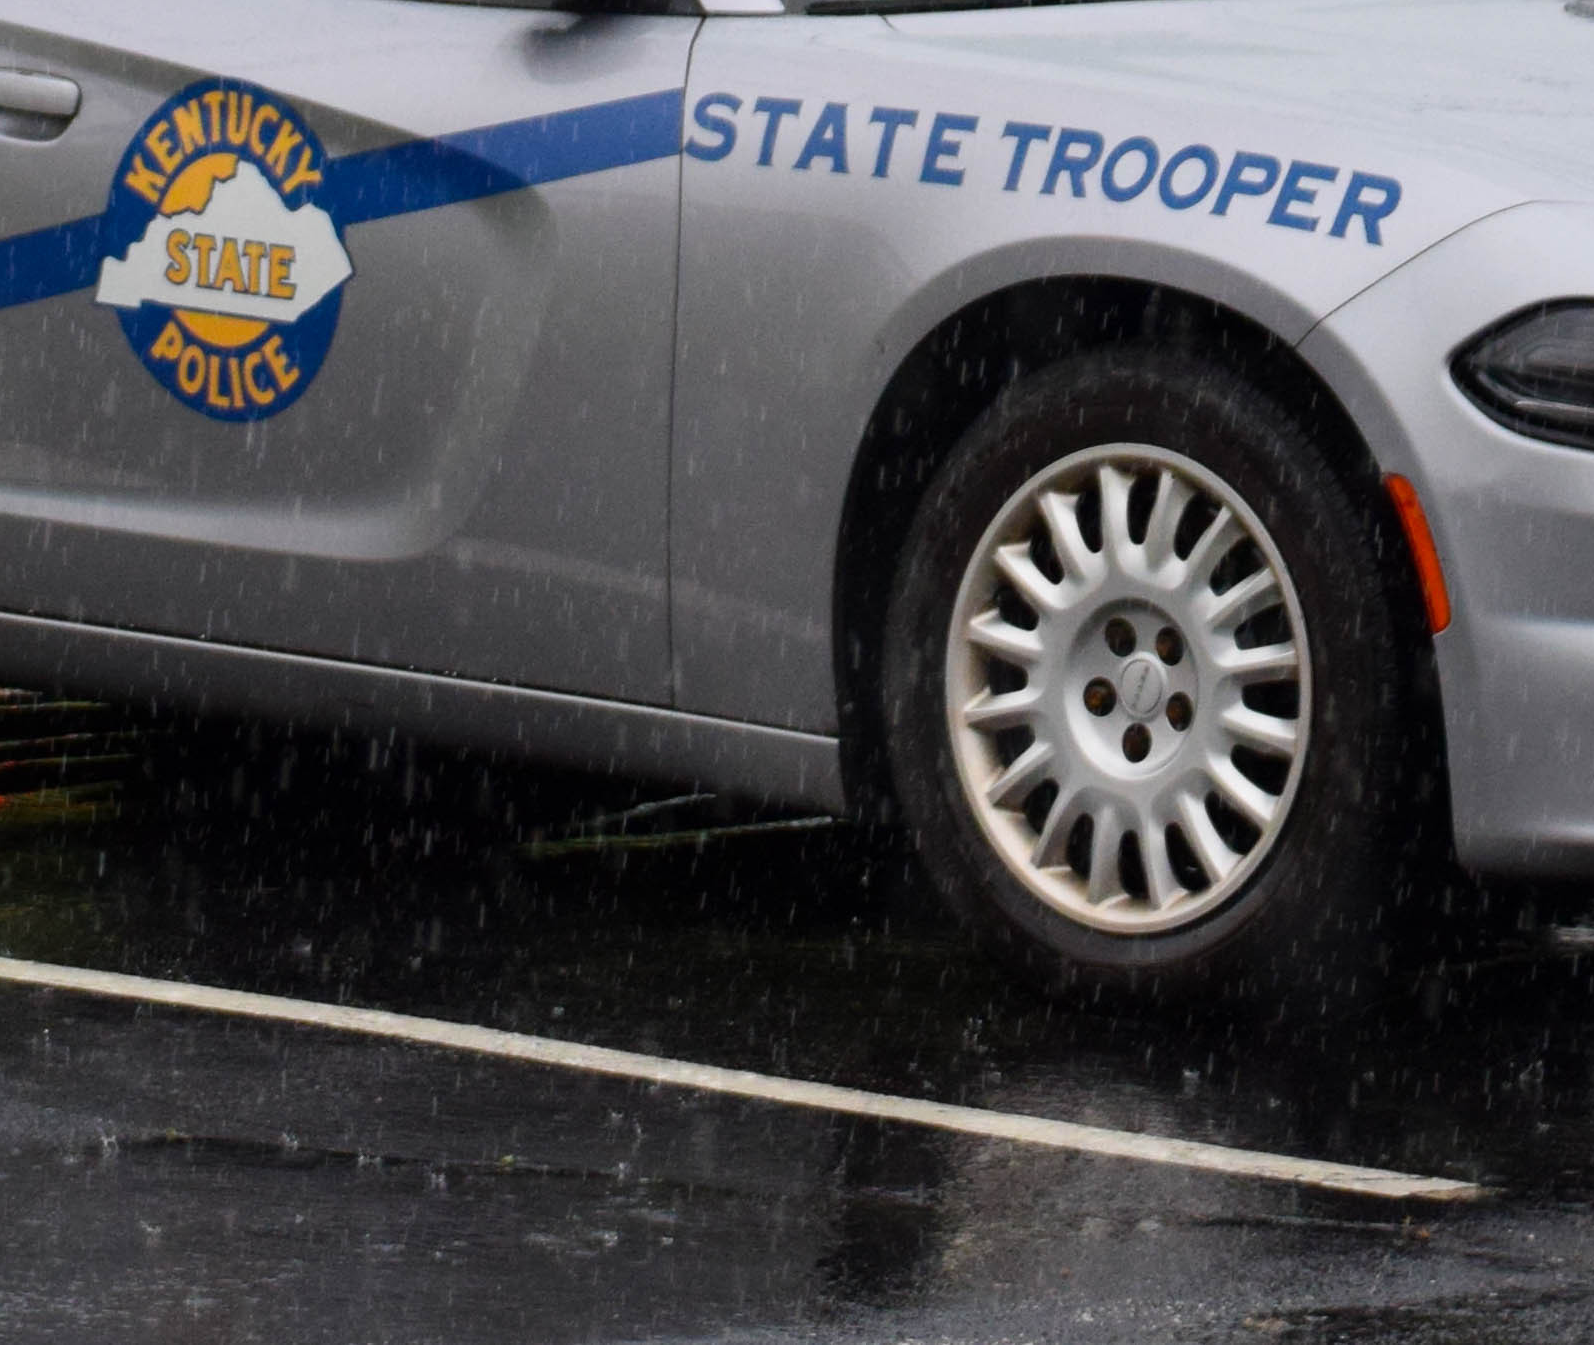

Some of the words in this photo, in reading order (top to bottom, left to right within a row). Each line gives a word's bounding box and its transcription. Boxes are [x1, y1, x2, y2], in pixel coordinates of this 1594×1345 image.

[124, 91, 323, 204] KENTUCKY
[683, 91, 980, 187] STATE
[1000, 120, 1403, 247] TROOPER
[165, 228, 297, 300] STATE
[150, 320, 300, 409] POLICE
